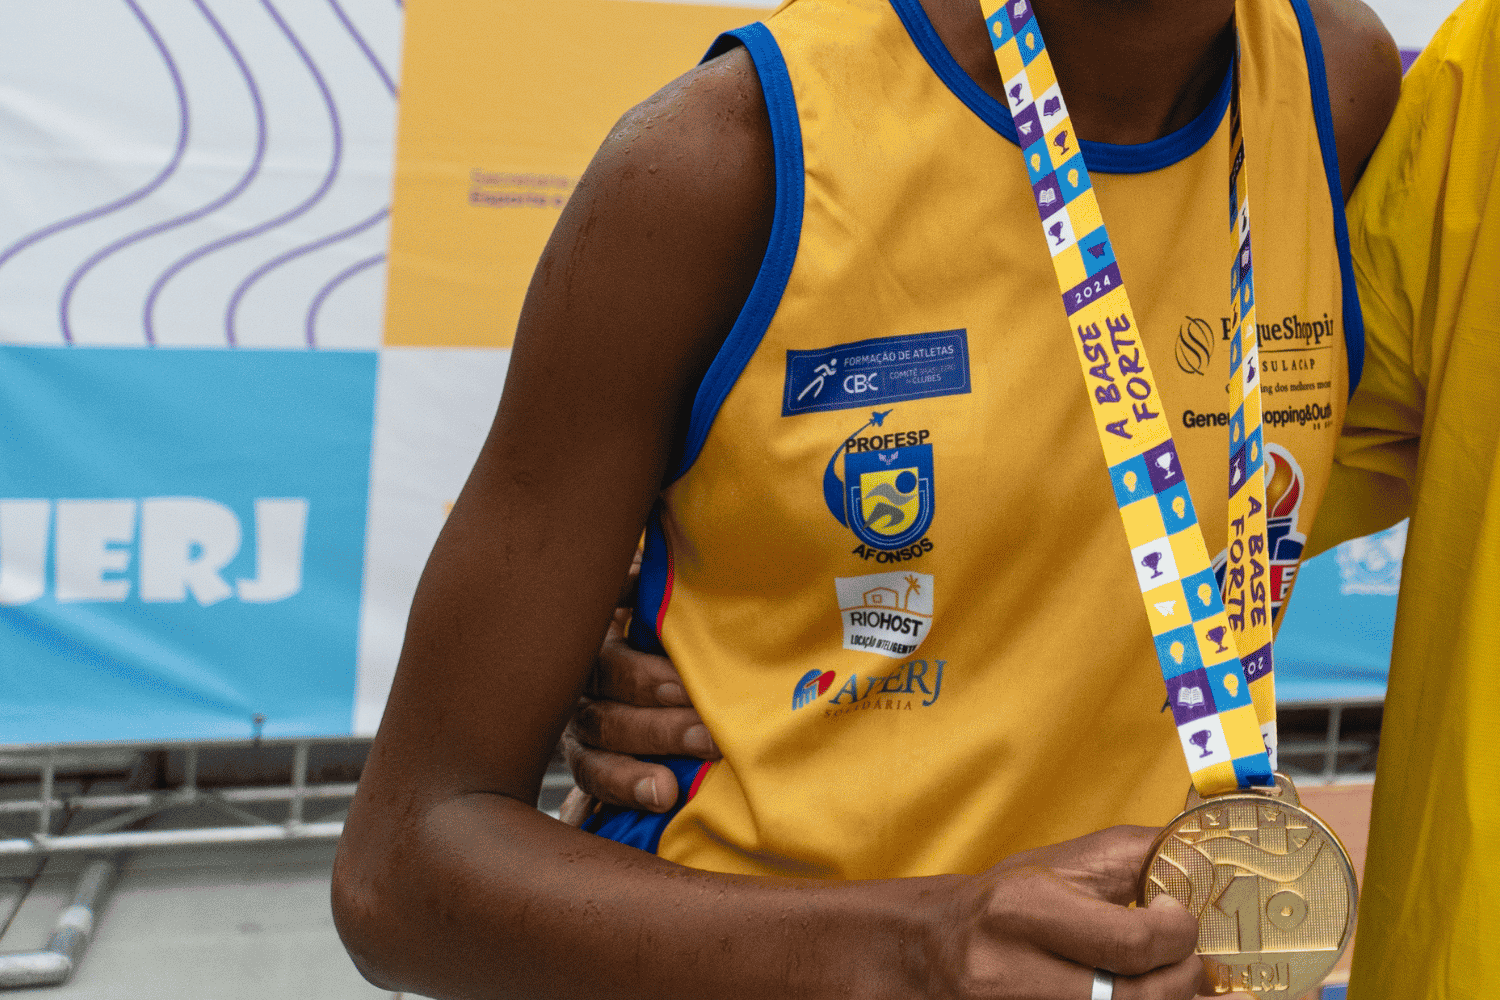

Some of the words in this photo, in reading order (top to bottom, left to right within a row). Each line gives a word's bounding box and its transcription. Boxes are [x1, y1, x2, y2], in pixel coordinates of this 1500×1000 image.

[1075, 275, 1111, 304] 2024
[843, 351, 896, 367] FORMAÇÃO
[898, 349, 910, 361] DE
[913, 344, 954, 359] ATLETAS
[1077, 322, 1122, 405] BASE
[1105, 313, 1160, 423] FORTE
[1262, 358, 1315, 373] SULACAP
[843, 372, 879, 394] CBC
[845, 429, 930, 455] PROFESP
[1105, 418, 1133, 440] A
[1248, 496, 1262, 519] A
[0, 494, 310, 607] JERJ
[852, 537, 934, 564] AFONSOS
[1228, 514, 1246, 632] FORTE
[1248, 532, 1267, 627] BASE
[850, 611, 923, 637] RIOHOST
